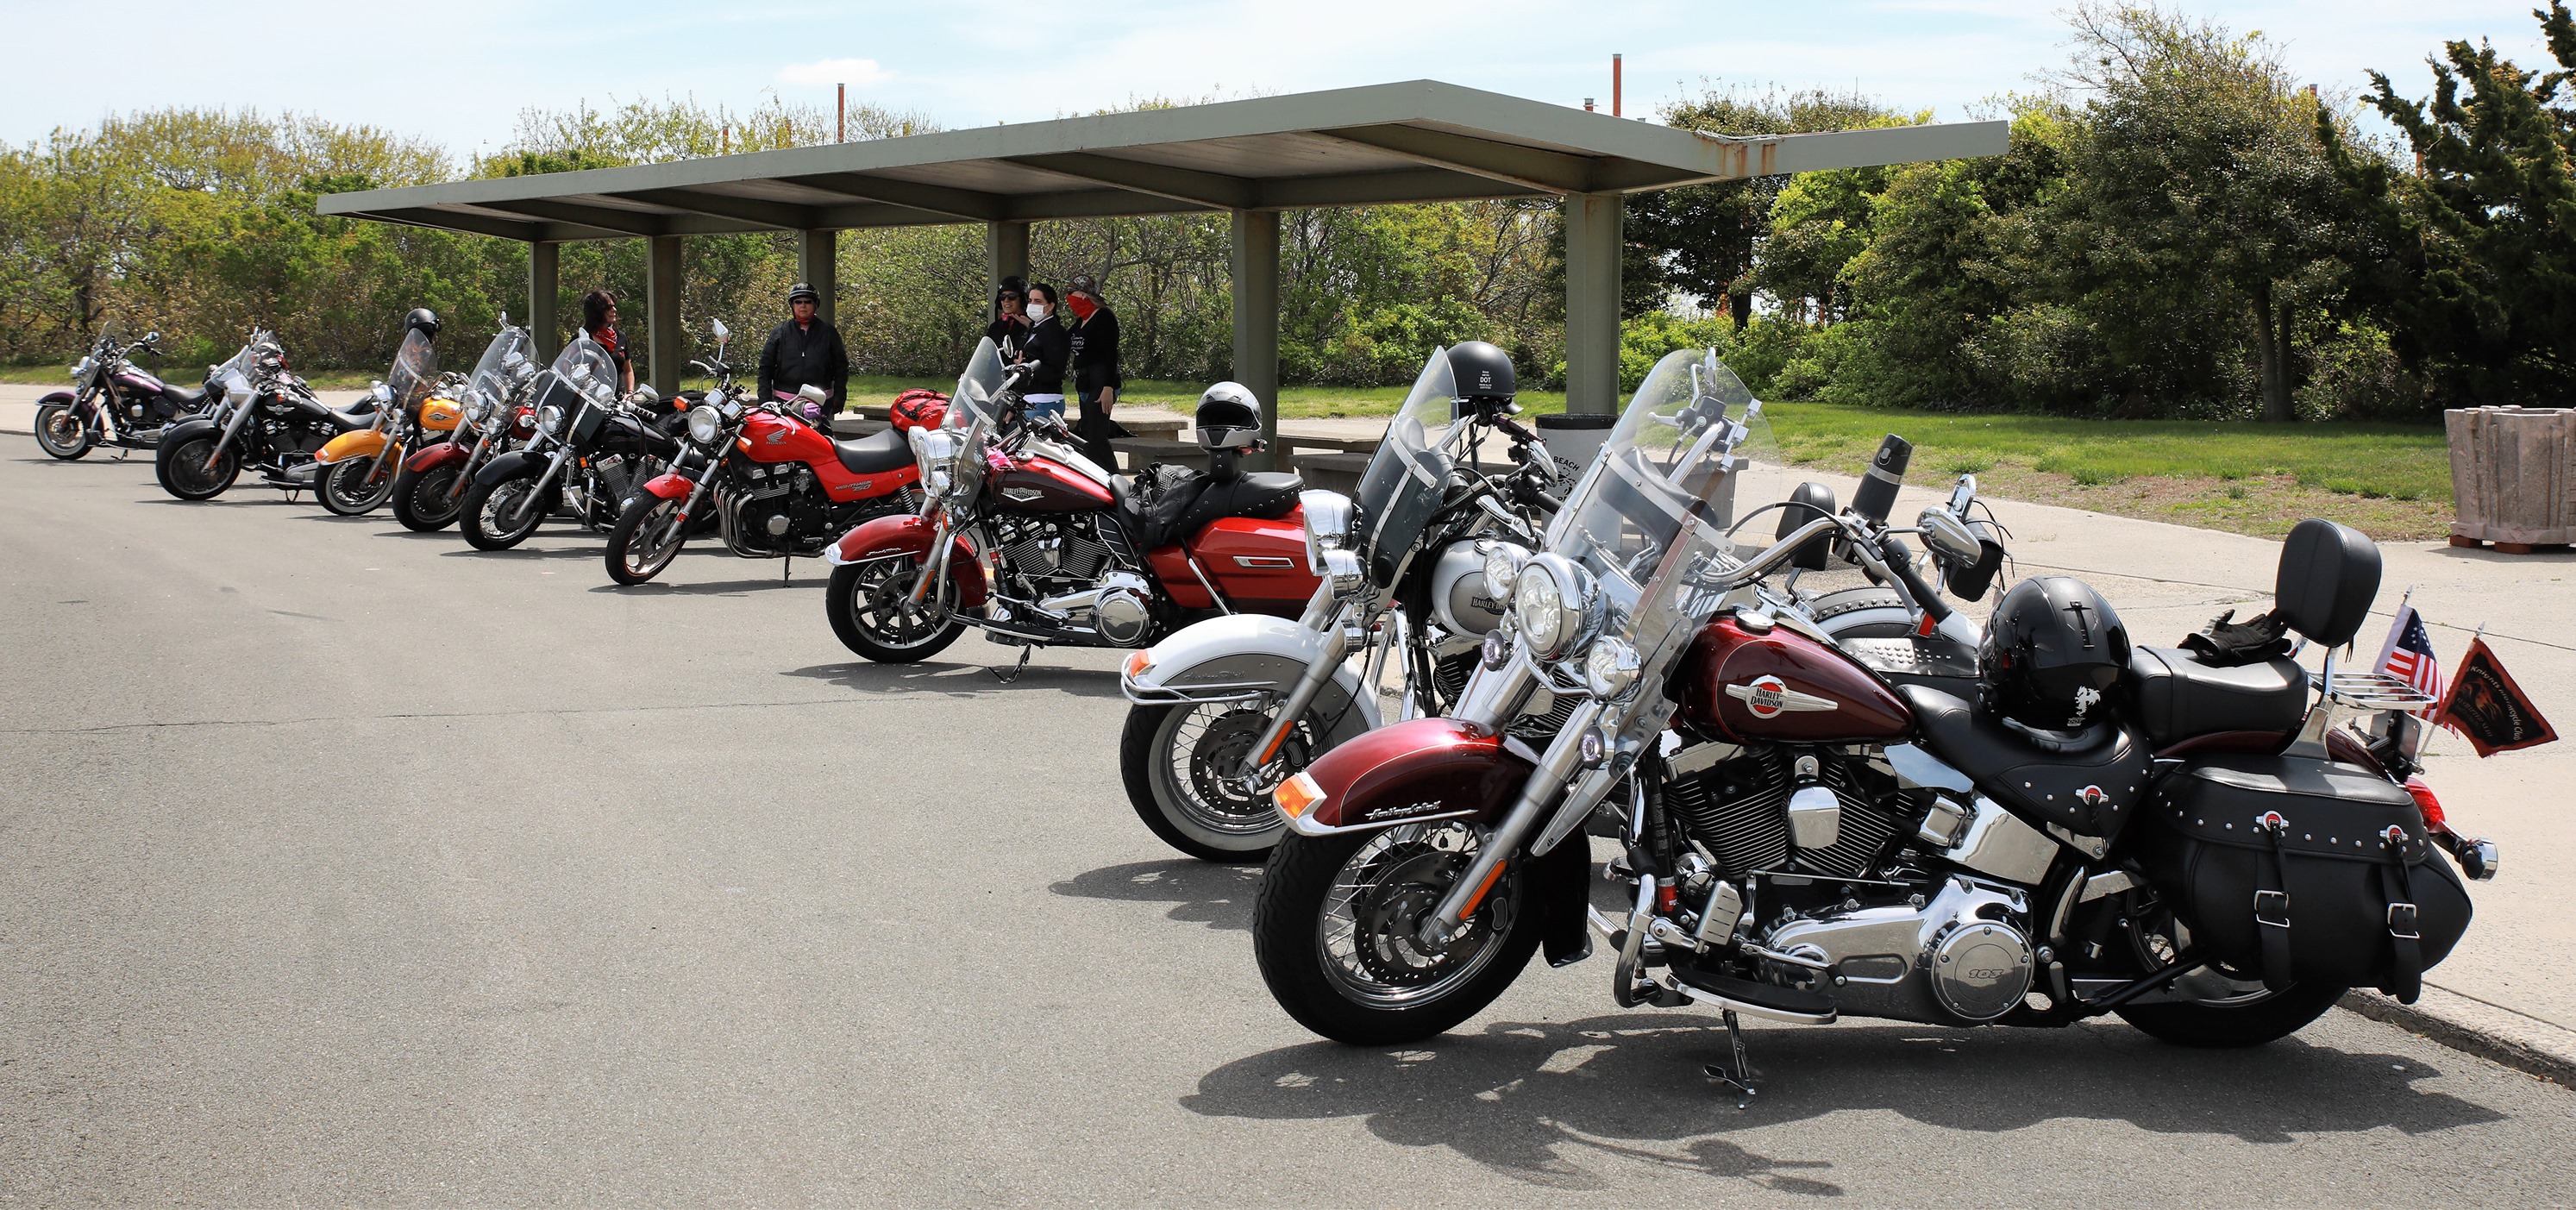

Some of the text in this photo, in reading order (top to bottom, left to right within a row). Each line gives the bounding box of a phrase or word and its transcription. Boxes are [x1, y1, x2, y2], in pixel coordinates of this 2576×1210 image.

[1553, 456, 1580, 471] BEACH
[1751, 696, 1783, 708] DAVIDSON
[2470, 665, 2500, 689] Knights
[2513, 726, 2523, 741] Club
[1969, 969, 2003, 979] 103
